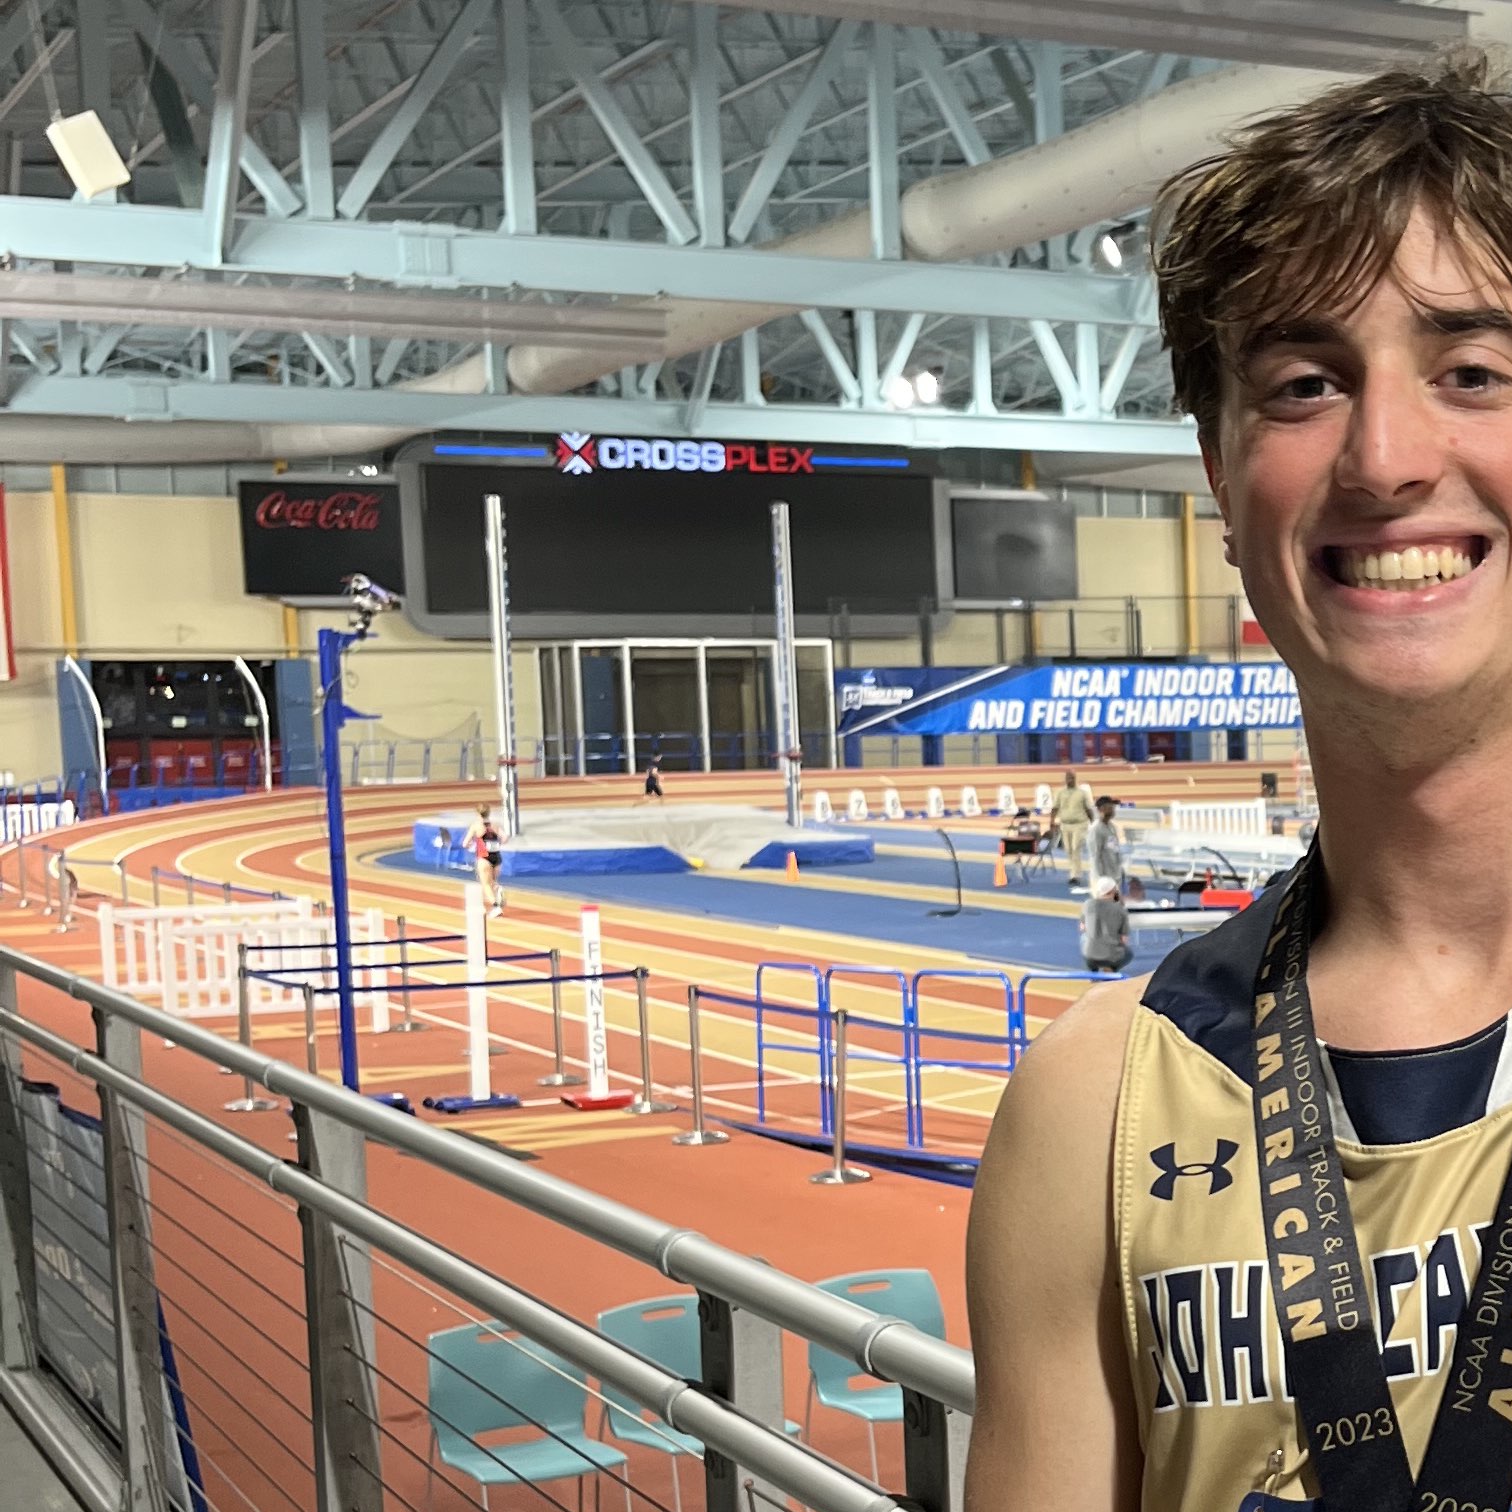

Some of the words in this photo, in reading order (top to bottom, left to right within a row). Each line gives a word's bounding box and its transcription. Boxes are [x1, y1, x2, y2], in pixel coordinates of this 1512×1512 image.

[600, 438, 815, 474] CROSSPLEX
[1051, 666, 1124, 698] NCAA
[1133, 667, 1234, 697] INDOOR
[968, 700, 1025, 730] AND
[1029, 699, 1104, 729] FIELD
[588, 941, 606, 1077] FINISH
[1279, 1010, 1303, 1029] III
[1255, 893, 1328, 1343] LL-AMERICAN
[1288, 1036, 1322, 1142] INDOOR
[1306, 1148, 1341, 1230] TRACK
[1323, 1237, 1344, 1256] &
[1328, 1261, 1359, 1331] FIELD
[1452, 1336, 1493, 1413] NCAA
[1315, 1406, 1395, 1452] 2023
